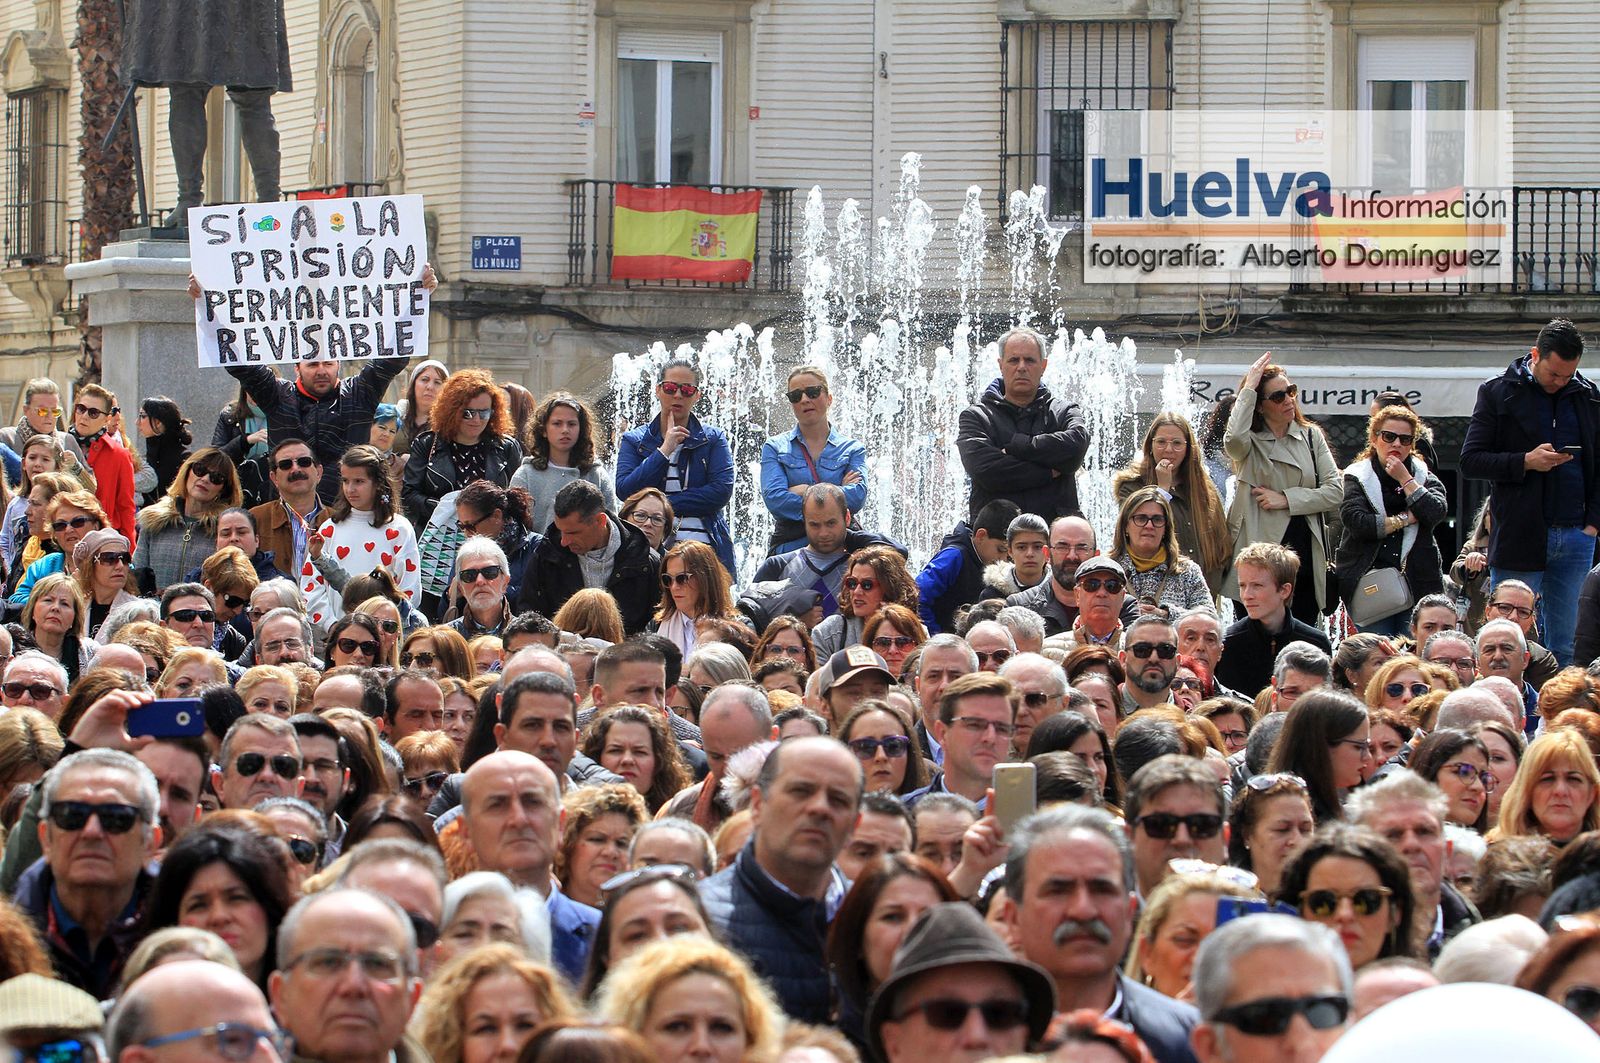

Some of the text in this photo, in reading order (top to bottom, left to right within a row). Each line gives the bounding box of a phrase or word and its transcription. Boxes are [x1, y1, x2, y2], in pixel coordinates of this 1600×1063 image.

[290, 204, 317, 241] A
[352, 200, 400, 237] LA
[486, 238, 515, 246] PLAZA
[474, 258, 519, 268] LAS MONJAS
[204, 280, 425, 323] PERMANENTE
[217, 320, 415, 364] REVISABLE
[1190, 380, 1422, 405] Reurane
